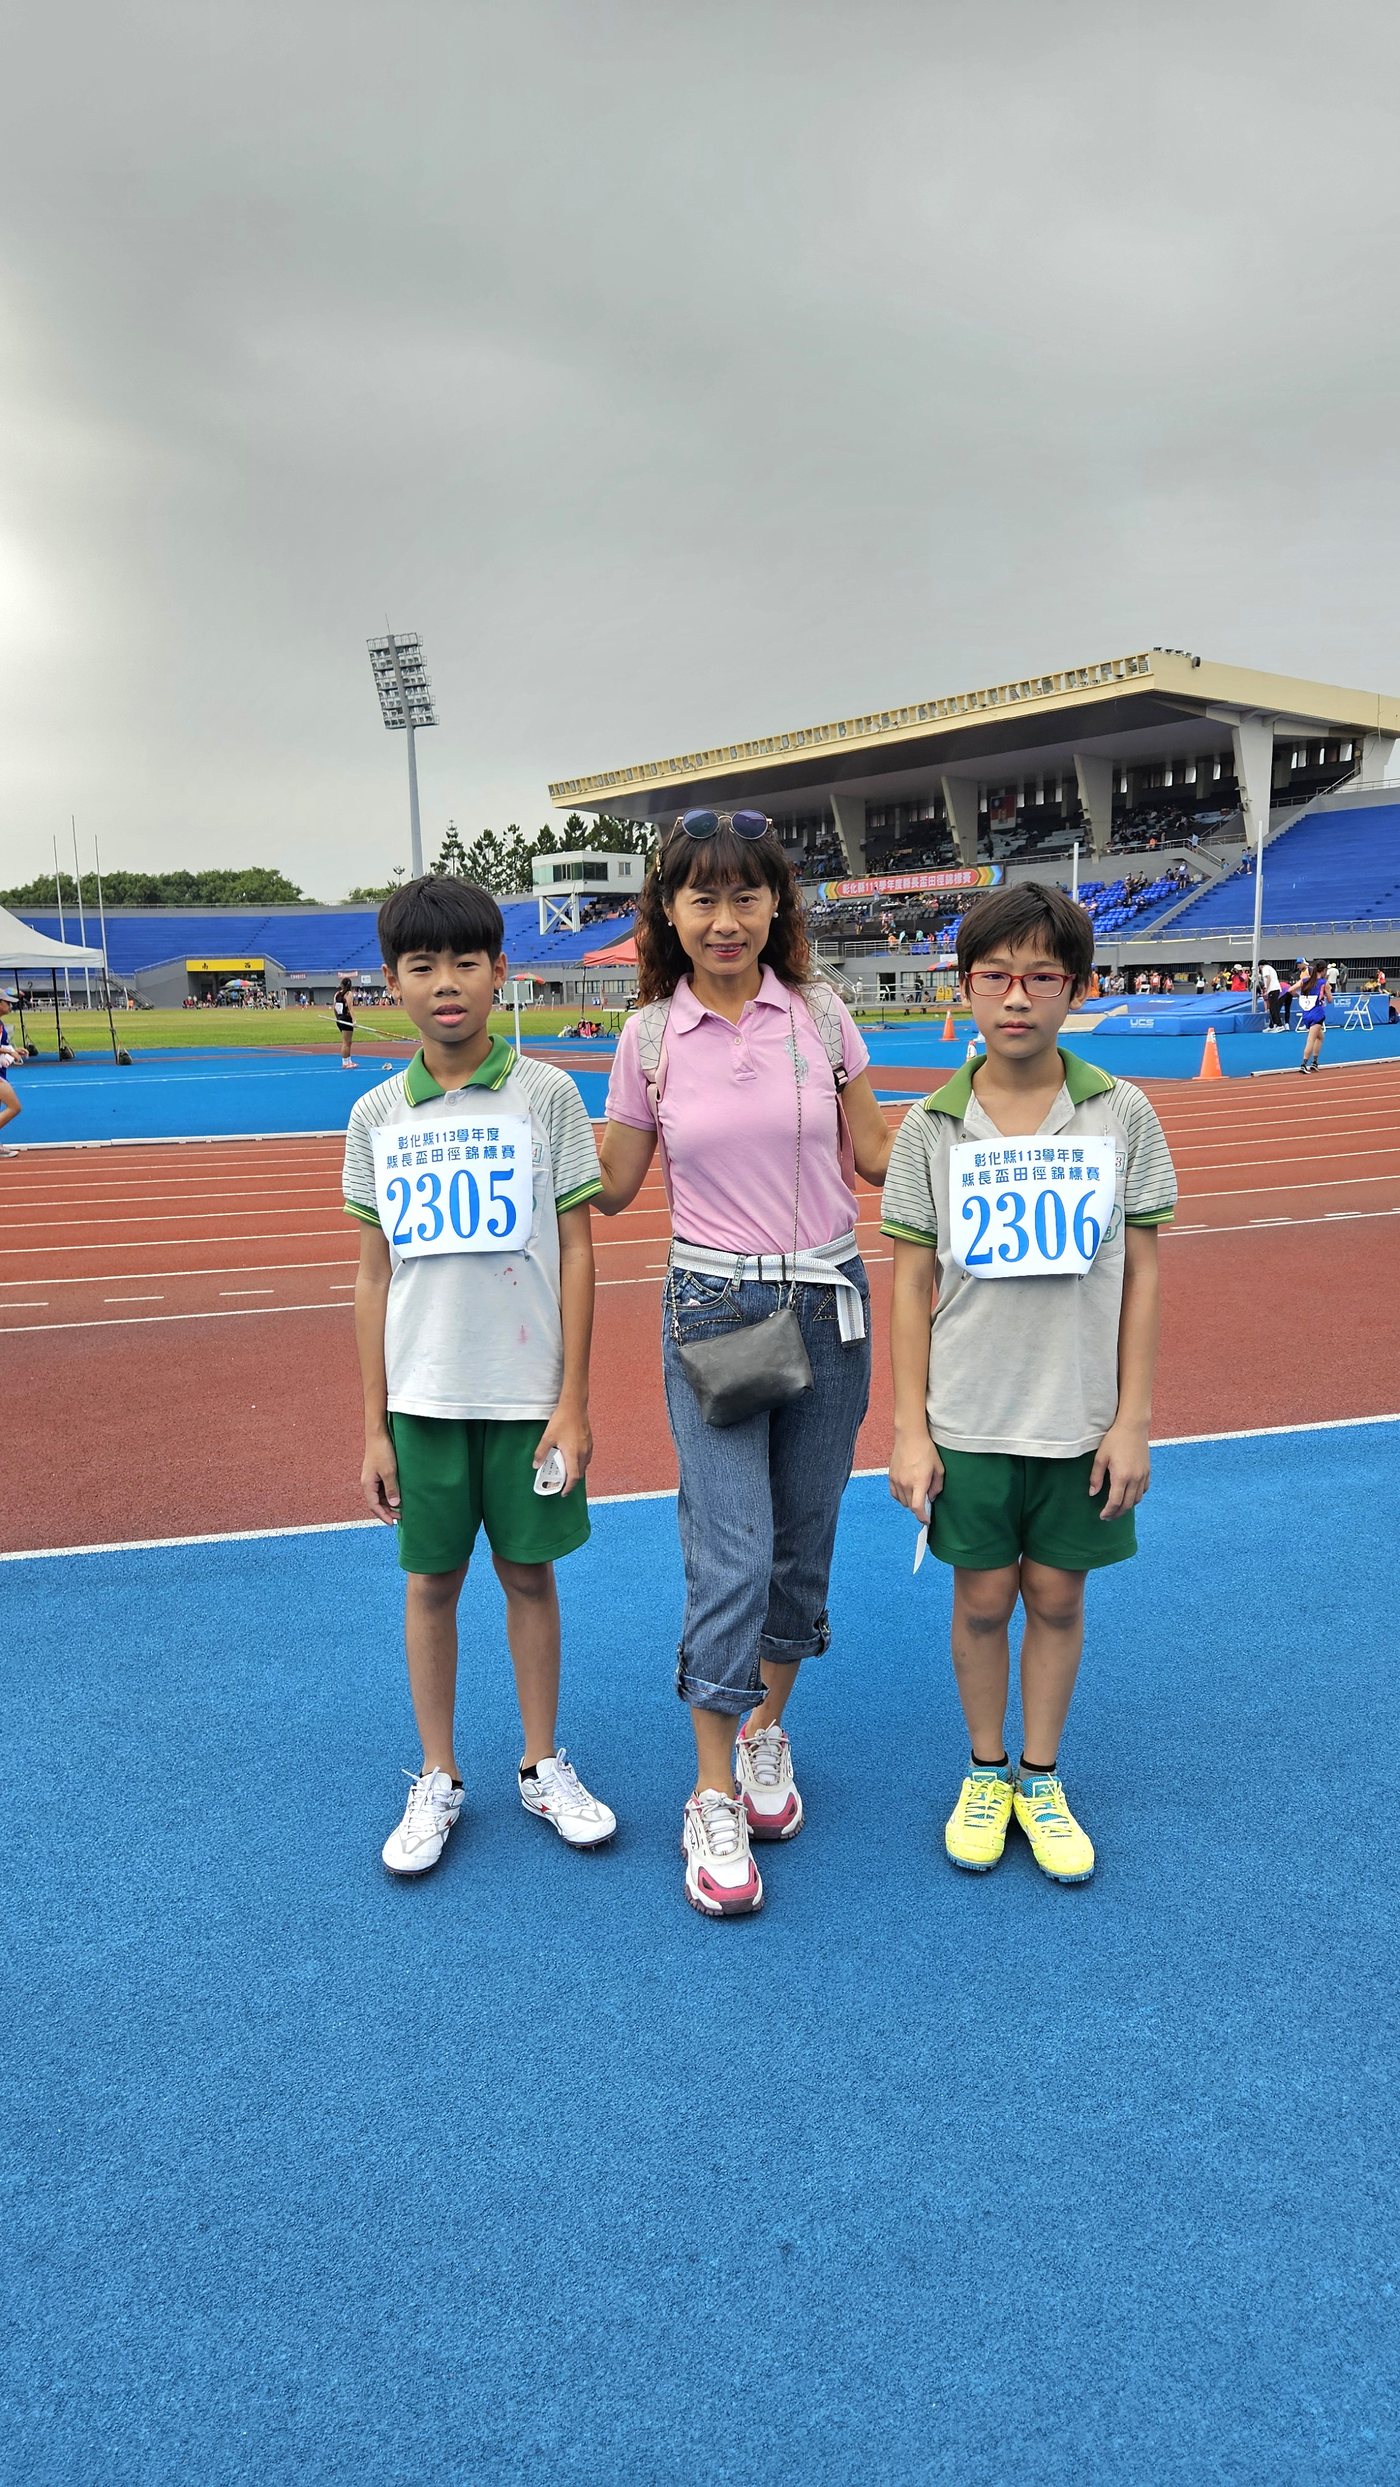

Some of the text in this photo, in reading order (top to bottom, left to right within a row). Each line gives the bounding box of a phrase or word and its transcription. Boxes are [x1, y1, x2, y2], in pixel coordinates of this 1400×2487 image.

[1130, 1018, 1155, 1026] UCS
[397, 1127, 500, 1150] 彰化縣113學年度
[386, 1144, 516, 1169] 縣長盃田徑錦標賽
[974, 1148, 1085, 1168] 彰化縣113學年度
[961, 1166, 1100, 1188] 縣長盃田徑錦標賽
[386, 1168, 517, 1246] 2305
[961, 1189, 1101, 1266] 2306
